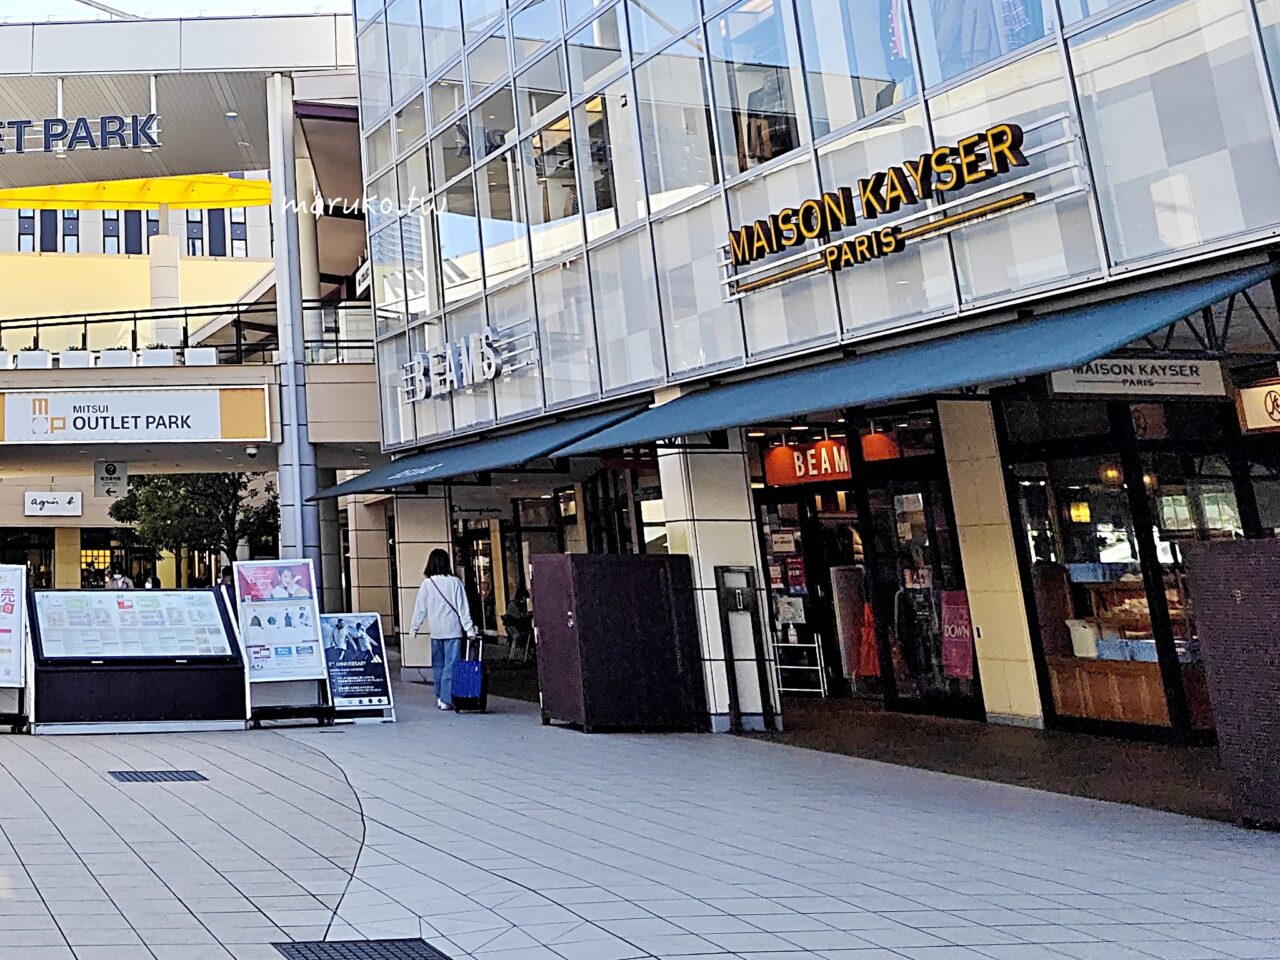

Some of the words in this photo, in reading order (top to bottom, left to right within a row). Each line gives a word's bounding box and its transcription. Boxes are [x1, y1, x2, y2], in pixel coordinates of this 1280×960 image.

[43, 112, 162, 153] PARK
[728, 186, 856, 266] MAISON
[857, 123, 1030, 220] KAYSER
[824, 226, 906, 271] PARIS
[413, 326, 503, 401] BEAMS
[1139, 364, 1200, 377] KAYSER
[1123, 378, 1155, 387] PARIS
[72, 404, 109, 414] MITSUI
[72, 415, 141, 431] OUTLET
[146, 414, 192, 430] PARK
[944, 624, 970, 639] DOWN
